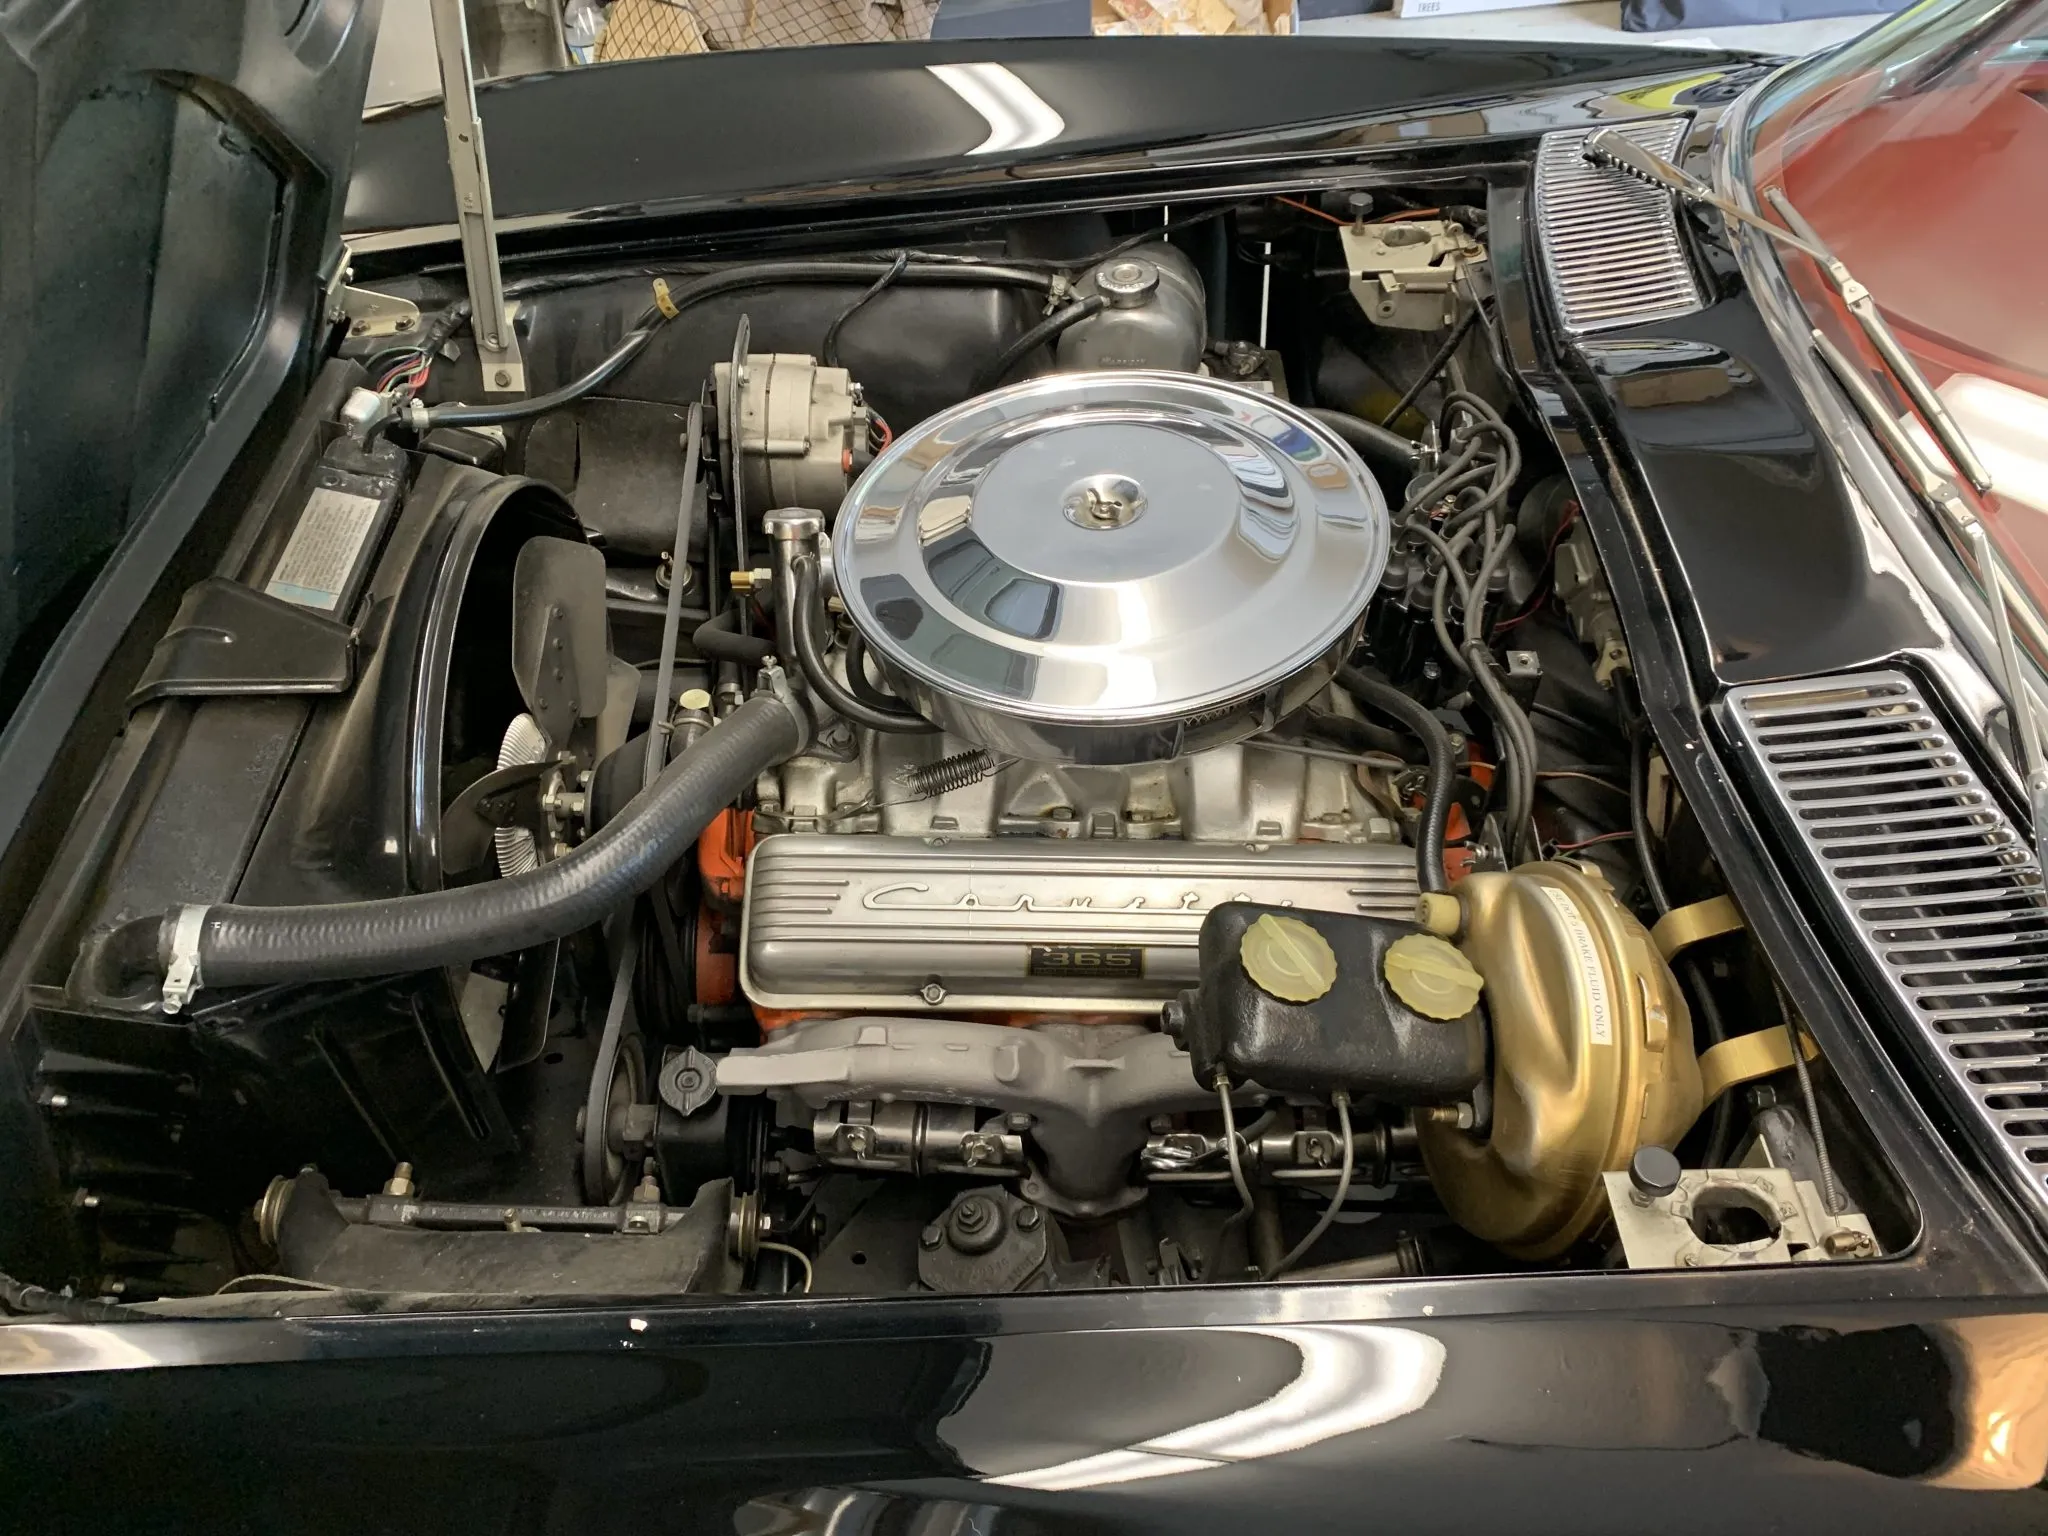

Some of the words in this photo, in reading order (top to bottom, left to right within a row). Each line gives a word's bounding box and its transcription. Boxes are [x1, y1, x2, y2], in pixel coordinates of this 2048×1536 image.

[1417, 2, 1441, 13] TREES
[862, 882, 1294, 914] Corvet
[1042, 951, 1133, 967] 365
[1574, 928, 1593, 962] BRAKE
[1587, 965, 1601, 1001] FLUID
[1594, 1004, 1606, 1038] ONLY
